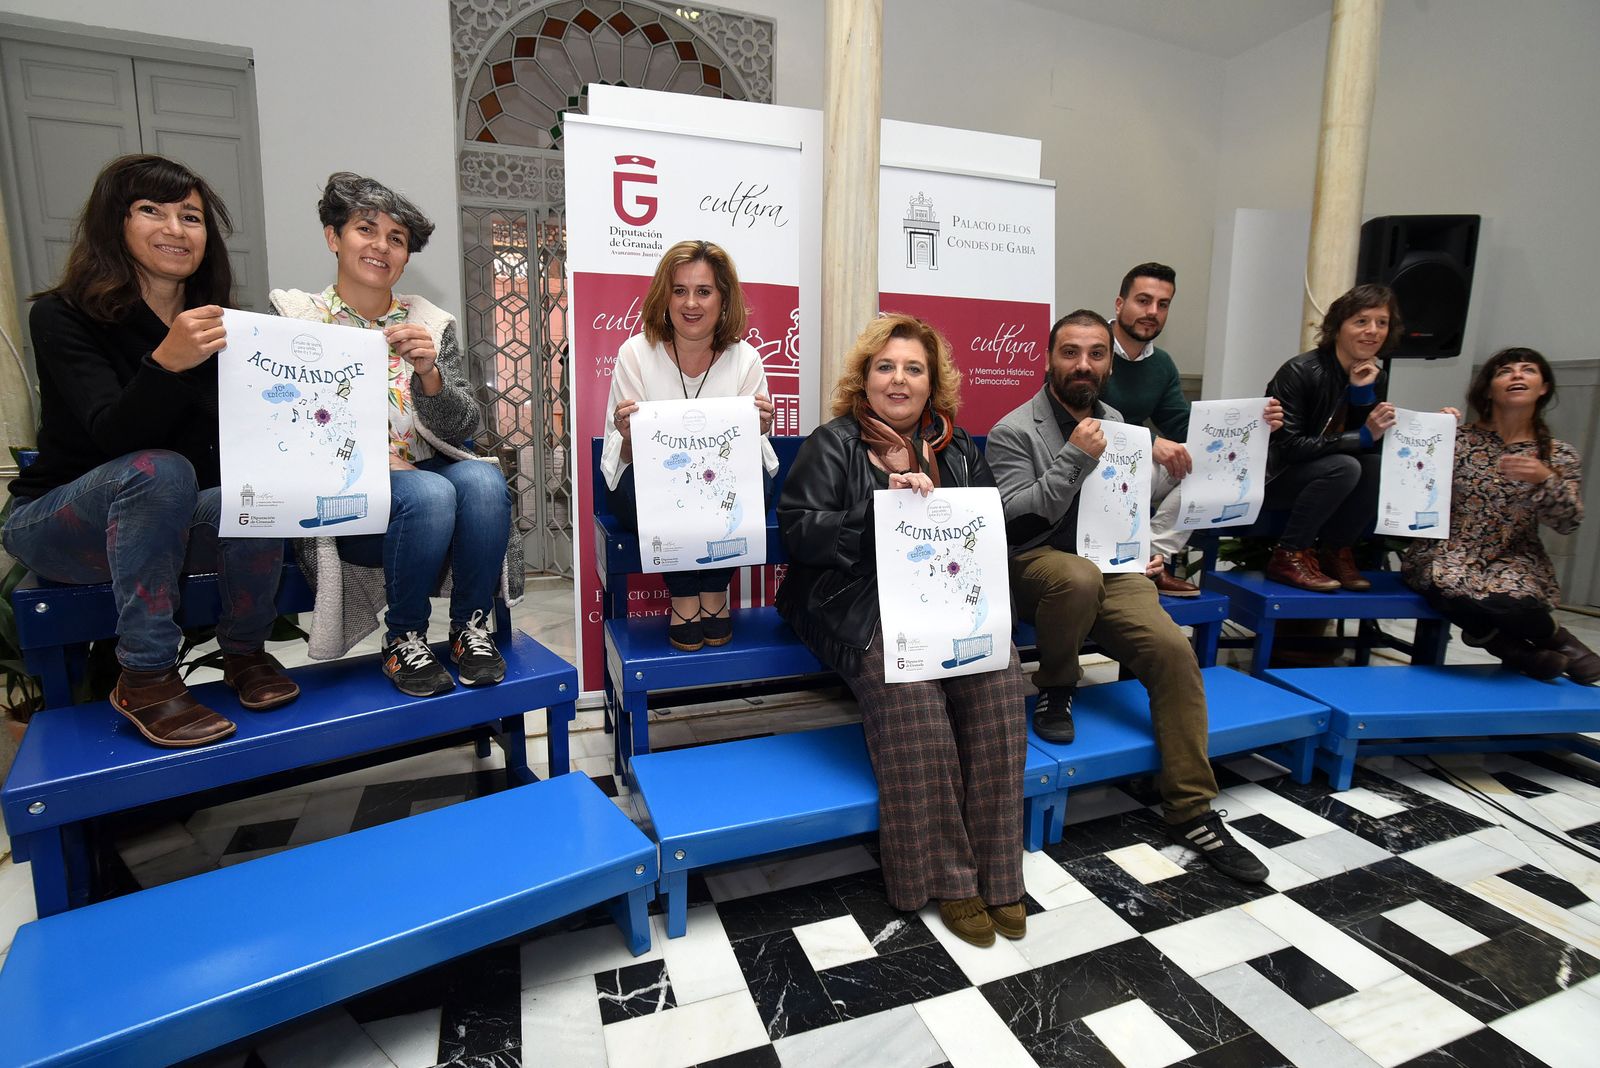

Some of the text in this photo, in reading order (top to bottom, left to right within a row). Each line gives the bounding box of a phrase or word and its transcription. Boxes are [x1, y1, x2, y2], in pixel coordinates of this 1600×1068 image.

[699, 181, 789, 228] cultura
[610, 226, 663, 239] Diputación
[952, 215, 1031, 235] PALACIO DE LOS
[610, 238, 663, 250] de Granada
[947, 236, 1036, 255] CONDES DE GABIA
[593, 296, 646, 339] cult
[970, 322, 1041, 364] cultura
[247, 351, 365, 384] ACUNÁNDOTE
[969, 367, 1035, 377] y Memoria Histórica
[969, 377, 1020, 386] y Democrática
[651, 425, 741, 451] ACUNÁNDOTE
[895, 515, 987, 542] ACUNÁNDOTE
